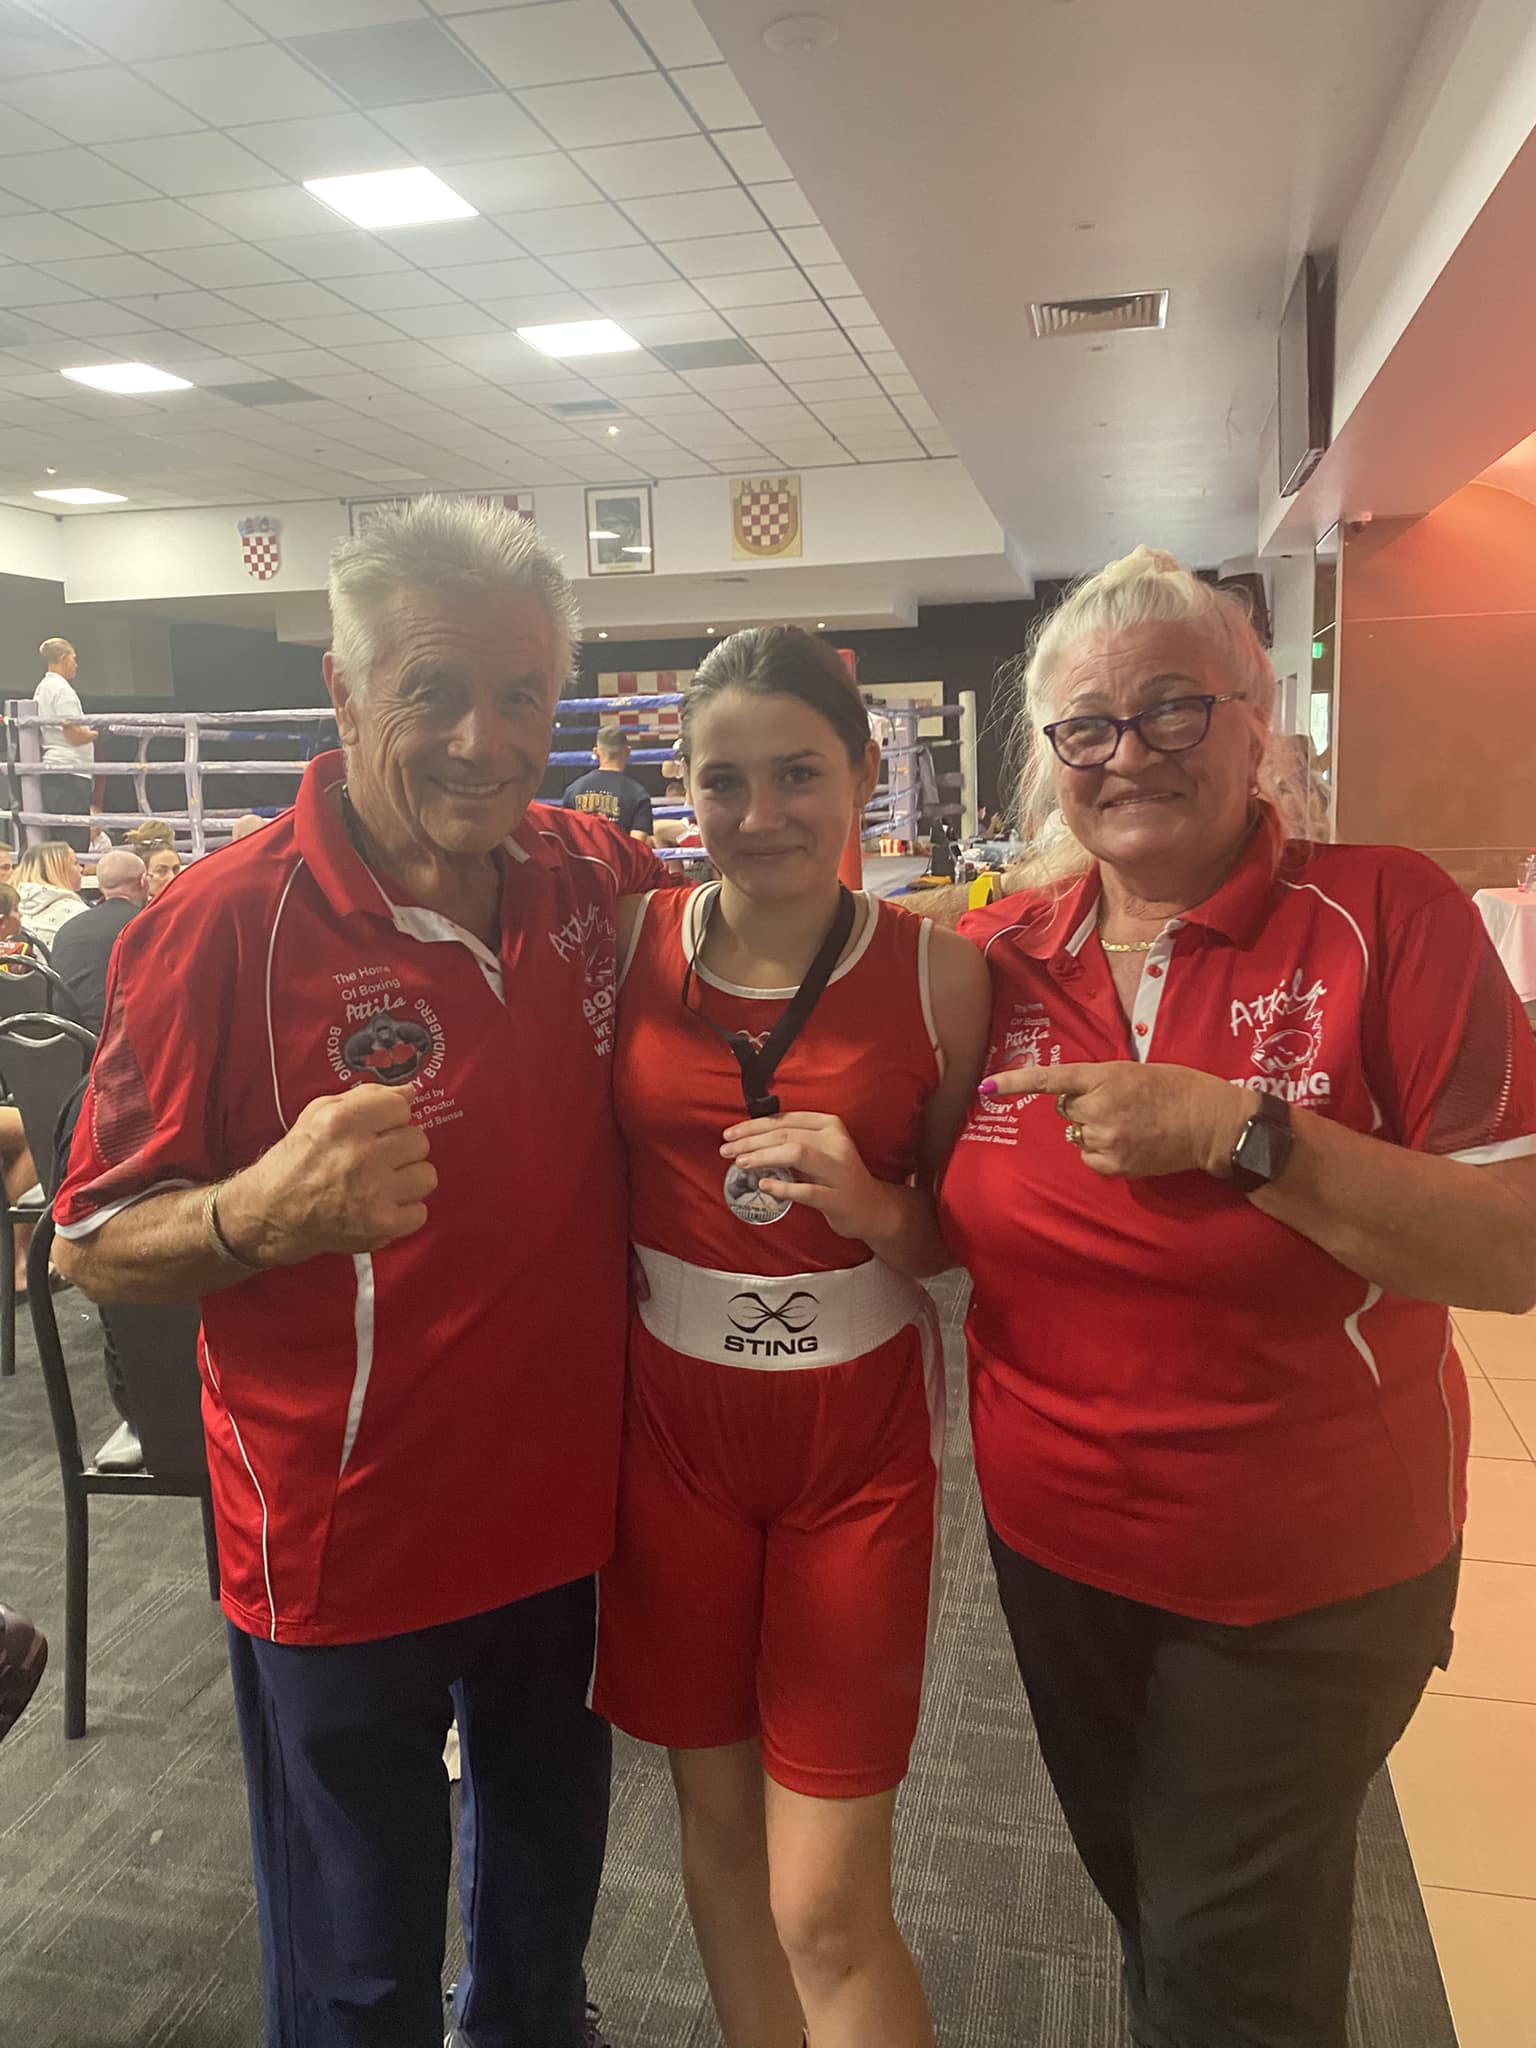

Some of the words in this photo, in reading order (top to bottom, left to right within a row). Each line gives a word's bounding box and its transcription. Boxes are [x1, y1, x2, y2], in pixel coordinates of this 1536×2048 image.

[332, 972, 357, 985] The
[341, 988, 357, 1001] Of
[359, 978, 401, 997] Boxing
[346, 993, 407, 1024] Attila
[1230, 968, 1327, 1036] Attila
[327, 1026, 351, 1081] BOXING
[414, 998, 446, 1079] BUNDABERG
[593, 1021, 612, 1039] WE
[594, 1039, 612, 1057] WE
[432, 1088, 445, 1097] by
[423, 1098, 455, 1114] Doctor
[724, 1335, 818, 1356] STING
